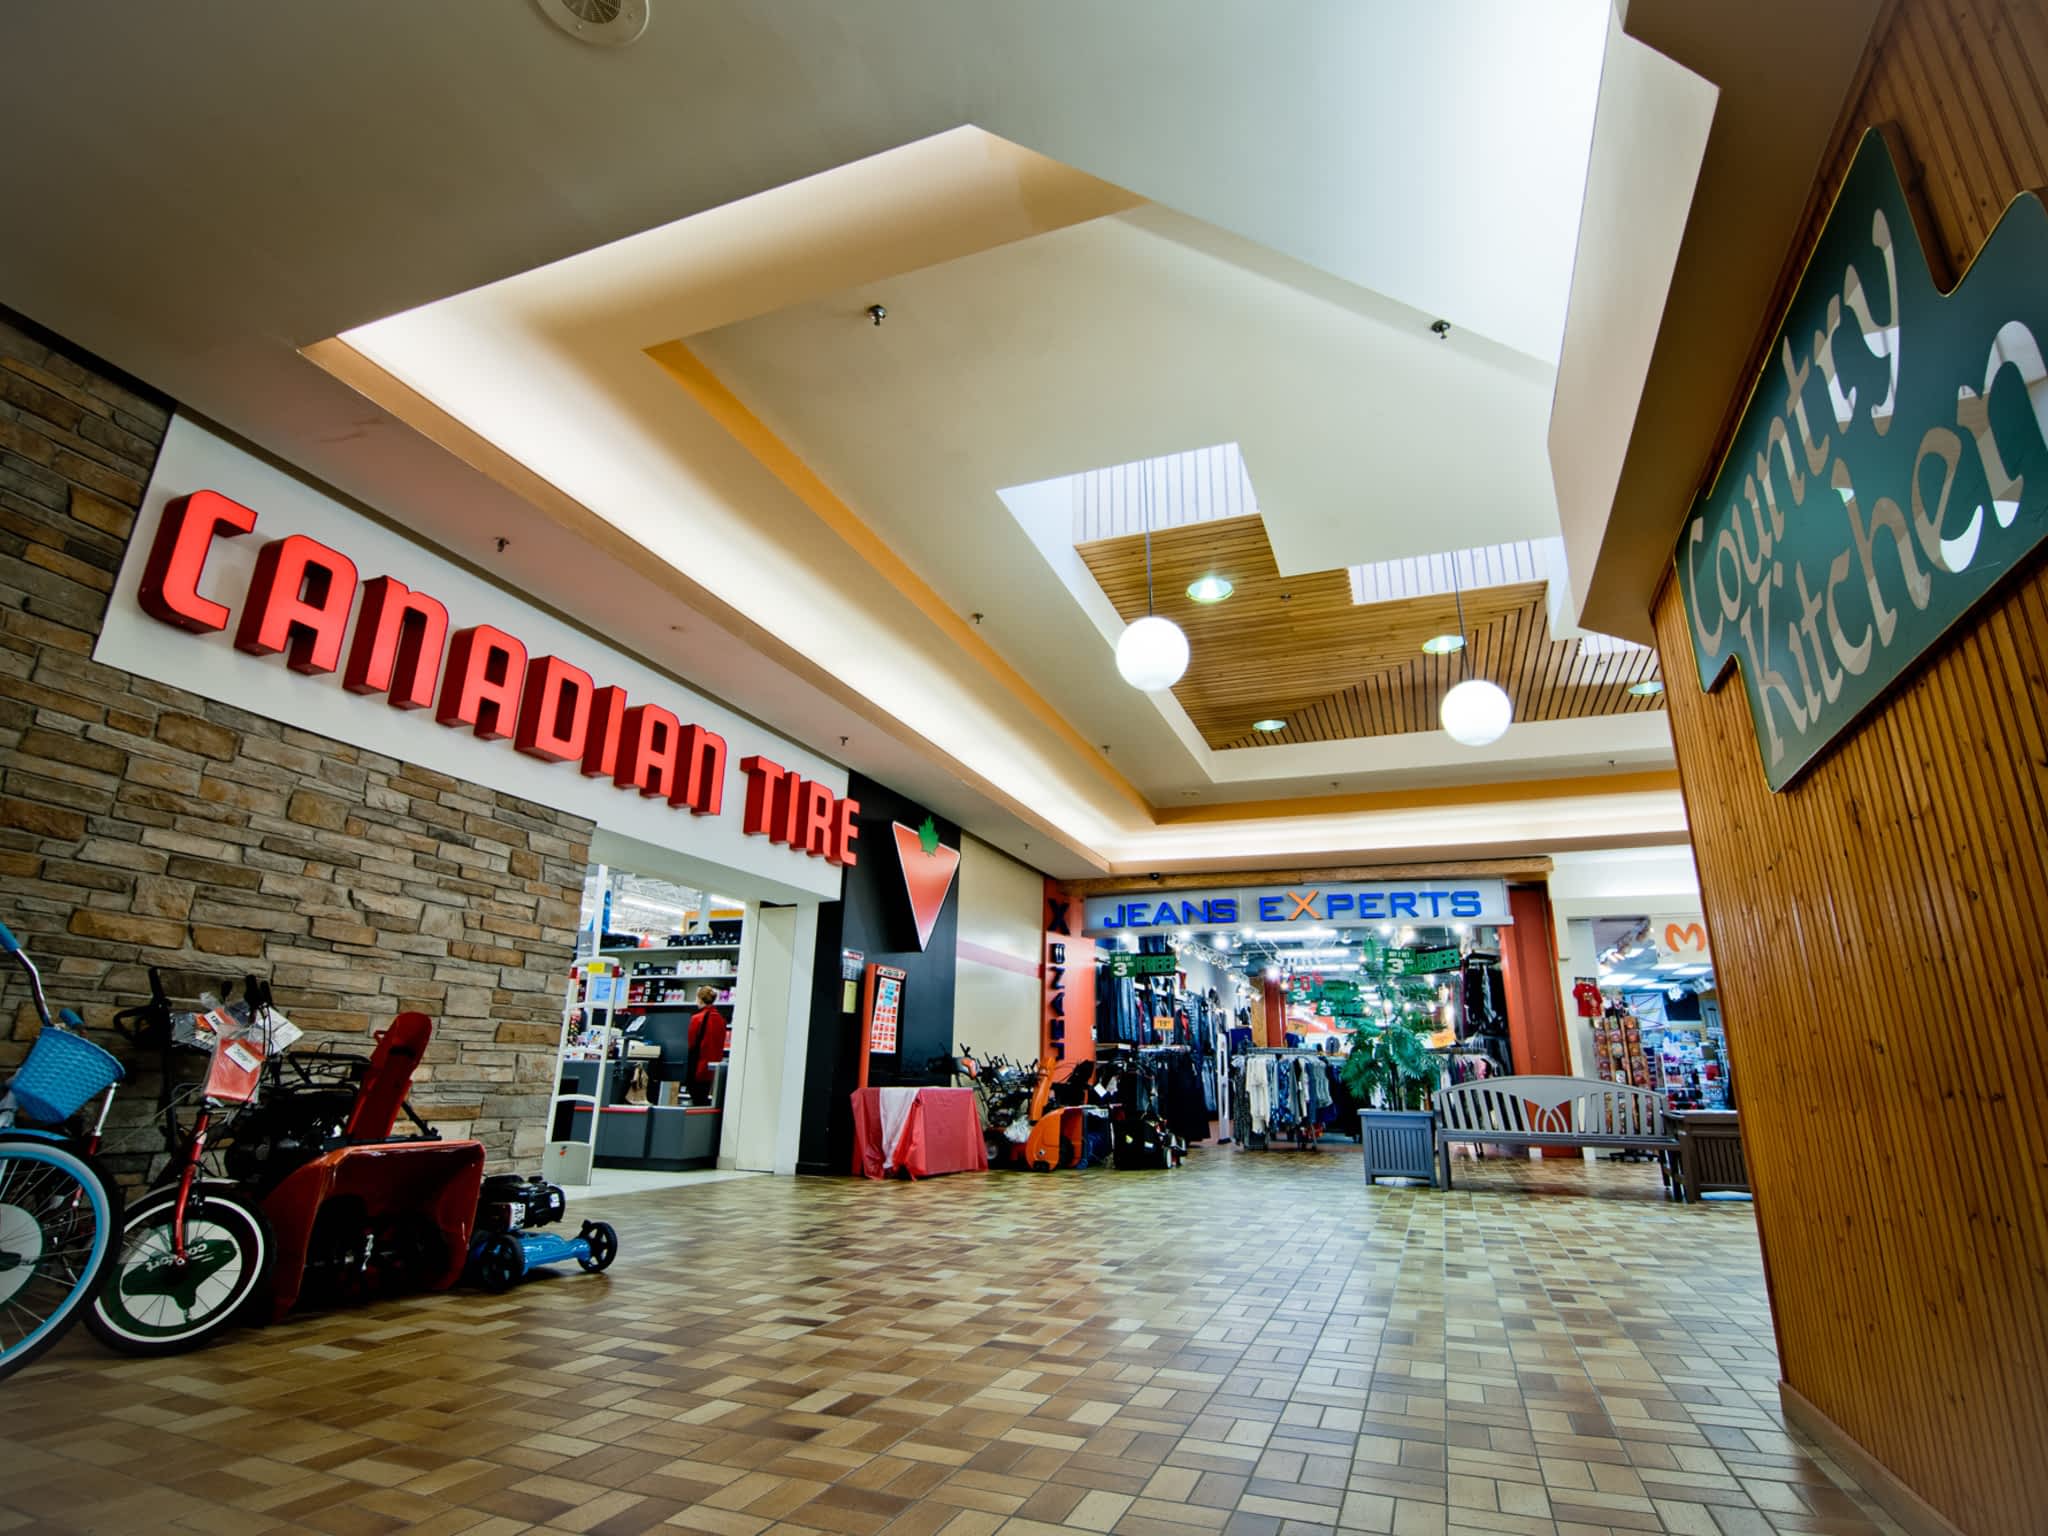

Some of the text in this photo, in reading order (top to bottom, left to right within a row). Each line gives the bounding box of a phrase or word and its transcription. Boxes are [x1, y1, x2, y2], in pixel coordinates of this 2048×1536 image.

[1689, 208, 1900, 657] Country
[1740, 320, 2048, 764] Kitchen
[137, 488, 861, 867] CANADIAN TIRE
[1047, 898, 1071, 936] X
[1103, 889, 1482, 928] JEANS EXPERTS
[1113, 962, 1128, 977] 3
[1387, 958, 1405, 974] 3
